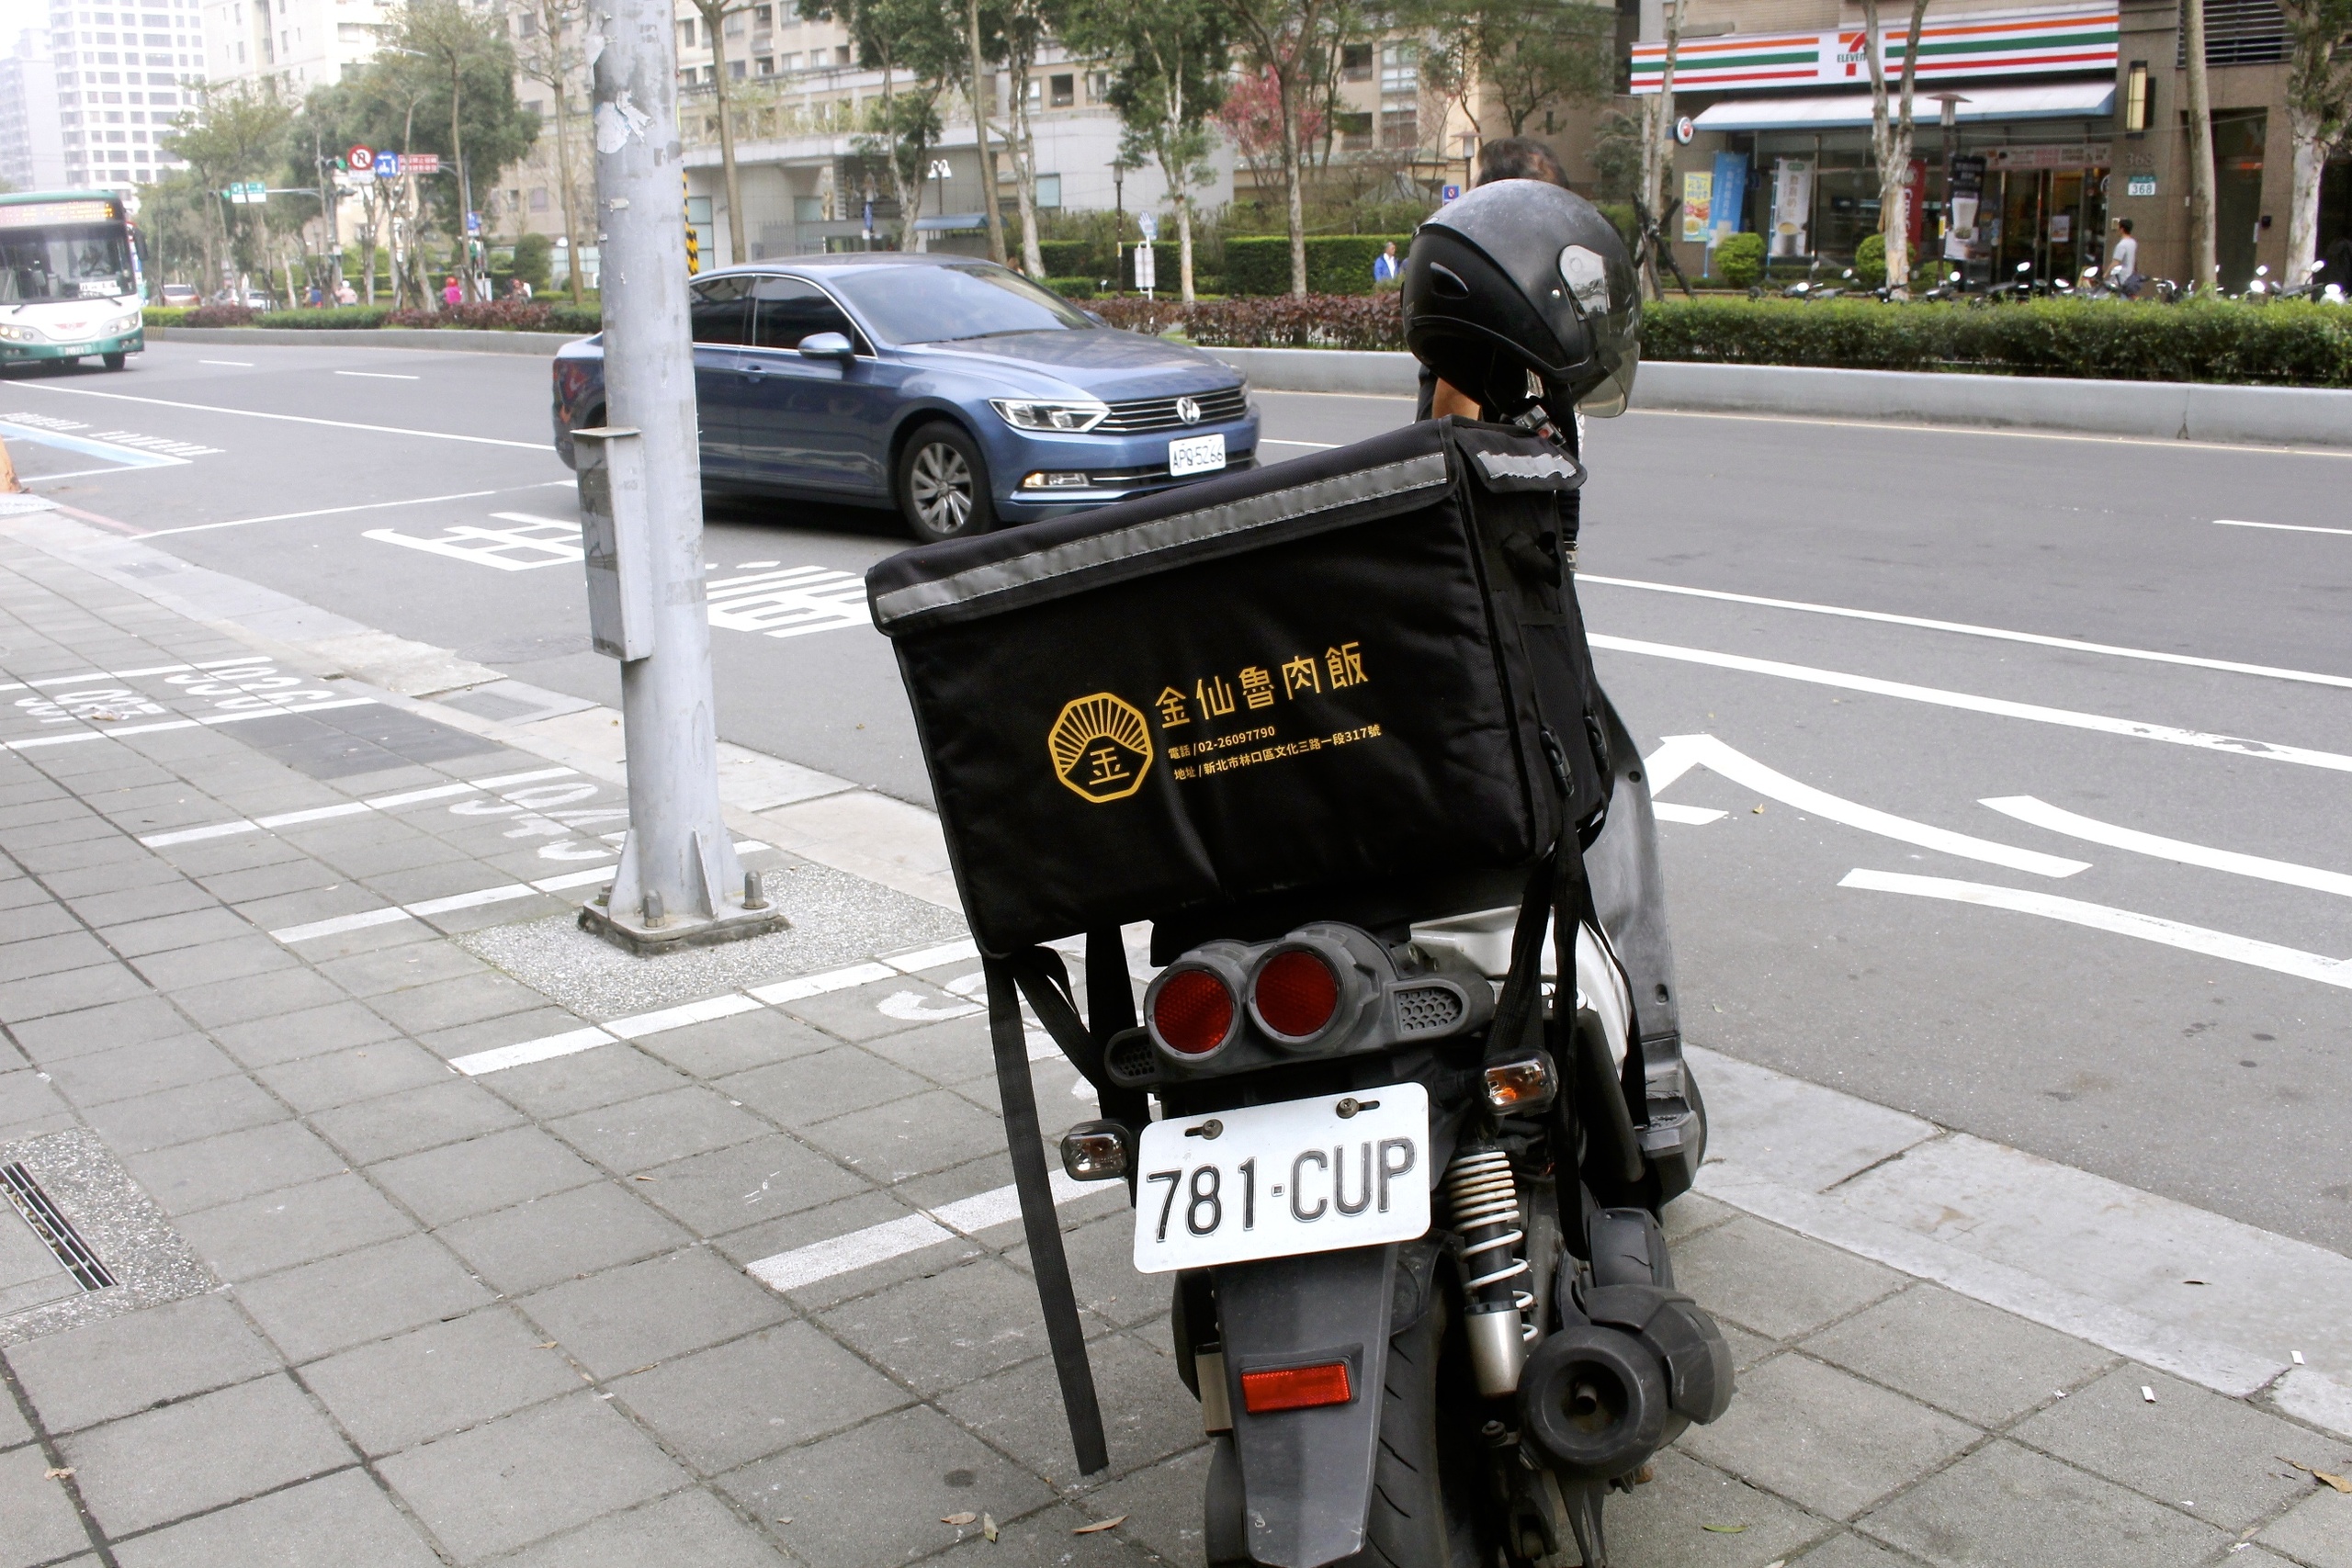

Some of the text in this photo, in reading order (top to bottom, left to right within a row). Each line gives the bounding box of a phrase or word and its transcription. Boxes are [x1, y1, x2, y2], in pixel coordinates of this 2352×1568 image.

[2132, 184, 2153, 194] 368
[1155, 642, 1368, 728] 金仙魯肉飯
[1147, 1136, 1418, 1243] 781-CUP
